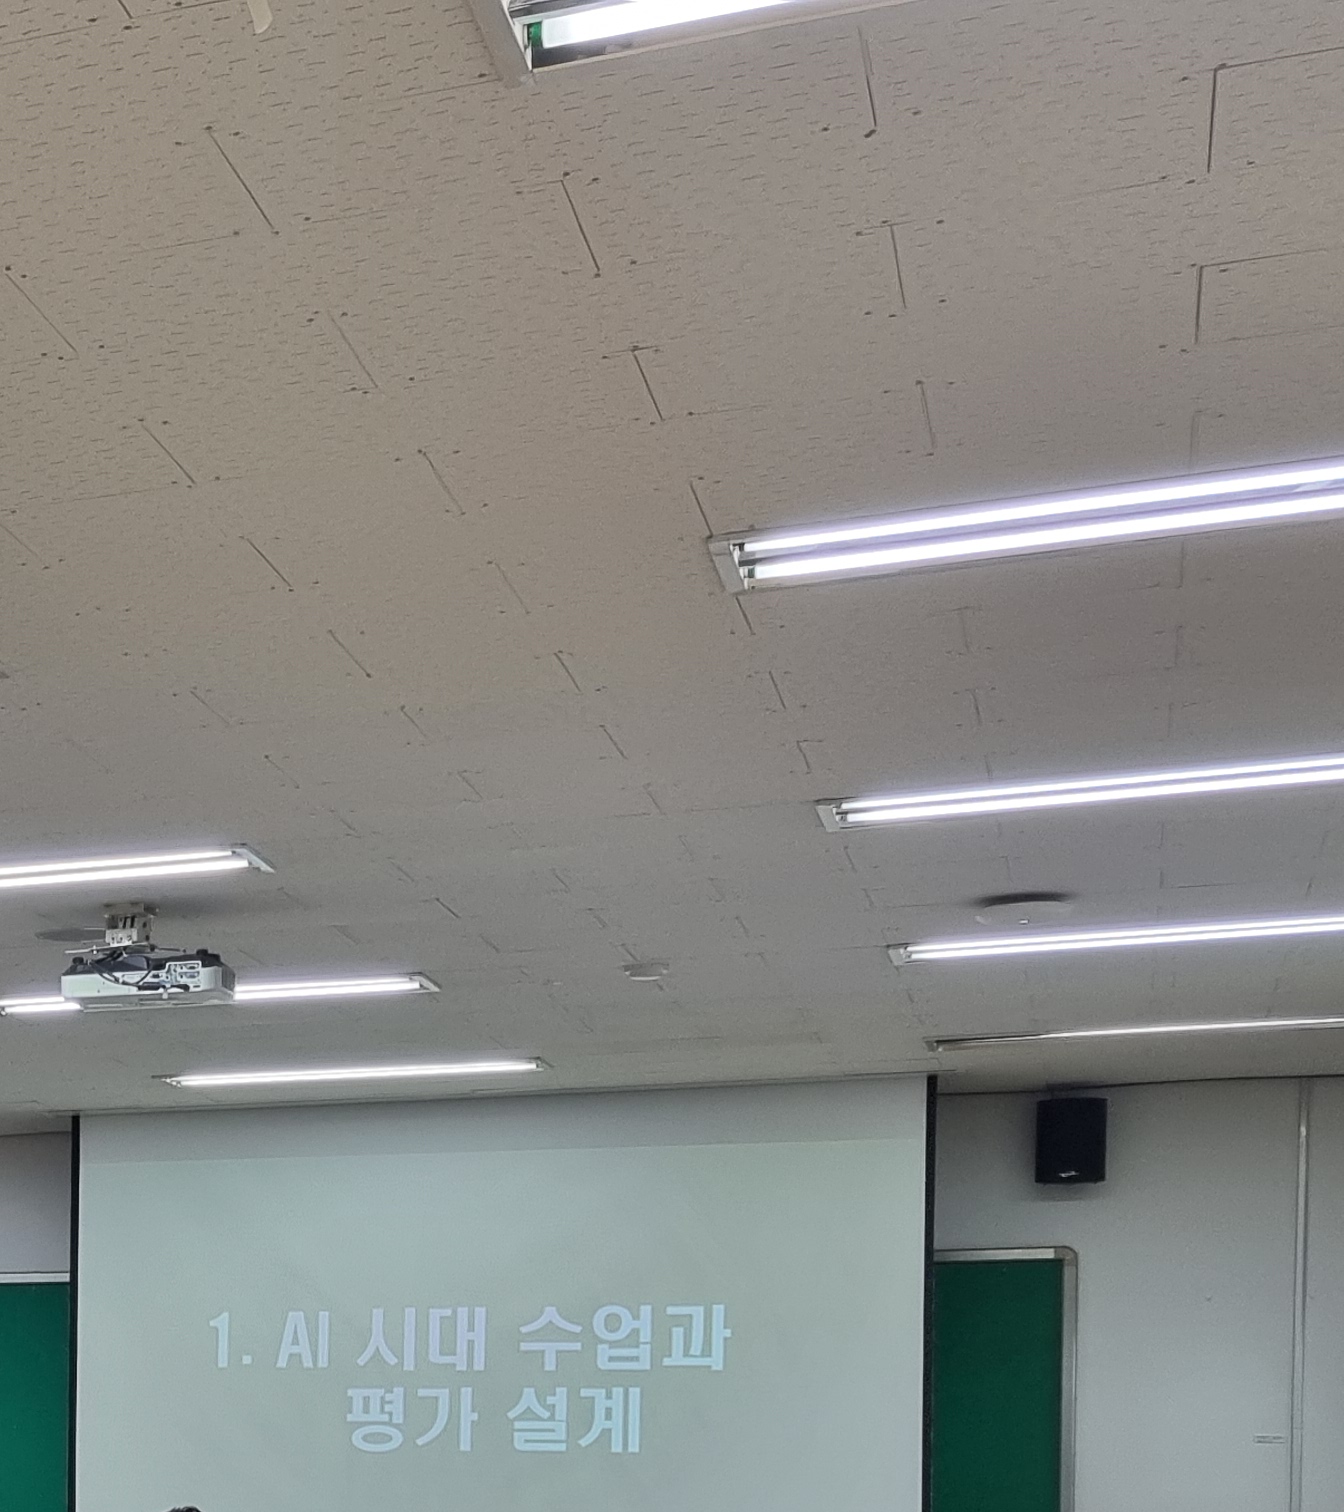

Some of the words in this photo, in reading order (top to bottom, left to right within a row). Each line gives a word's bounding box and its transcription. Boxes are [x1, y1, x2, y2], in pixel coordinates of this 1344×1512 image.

[209, 1311, 253, 1368] 1.
[276, 1311, 330, 1368] AI
[356, 1306, 486, 1371] 시대
[518, 1304, 732, 1371] 수업과
[346, 1387, 478, 1452] 평가
[506, 1386, 641, 1452] 설계
